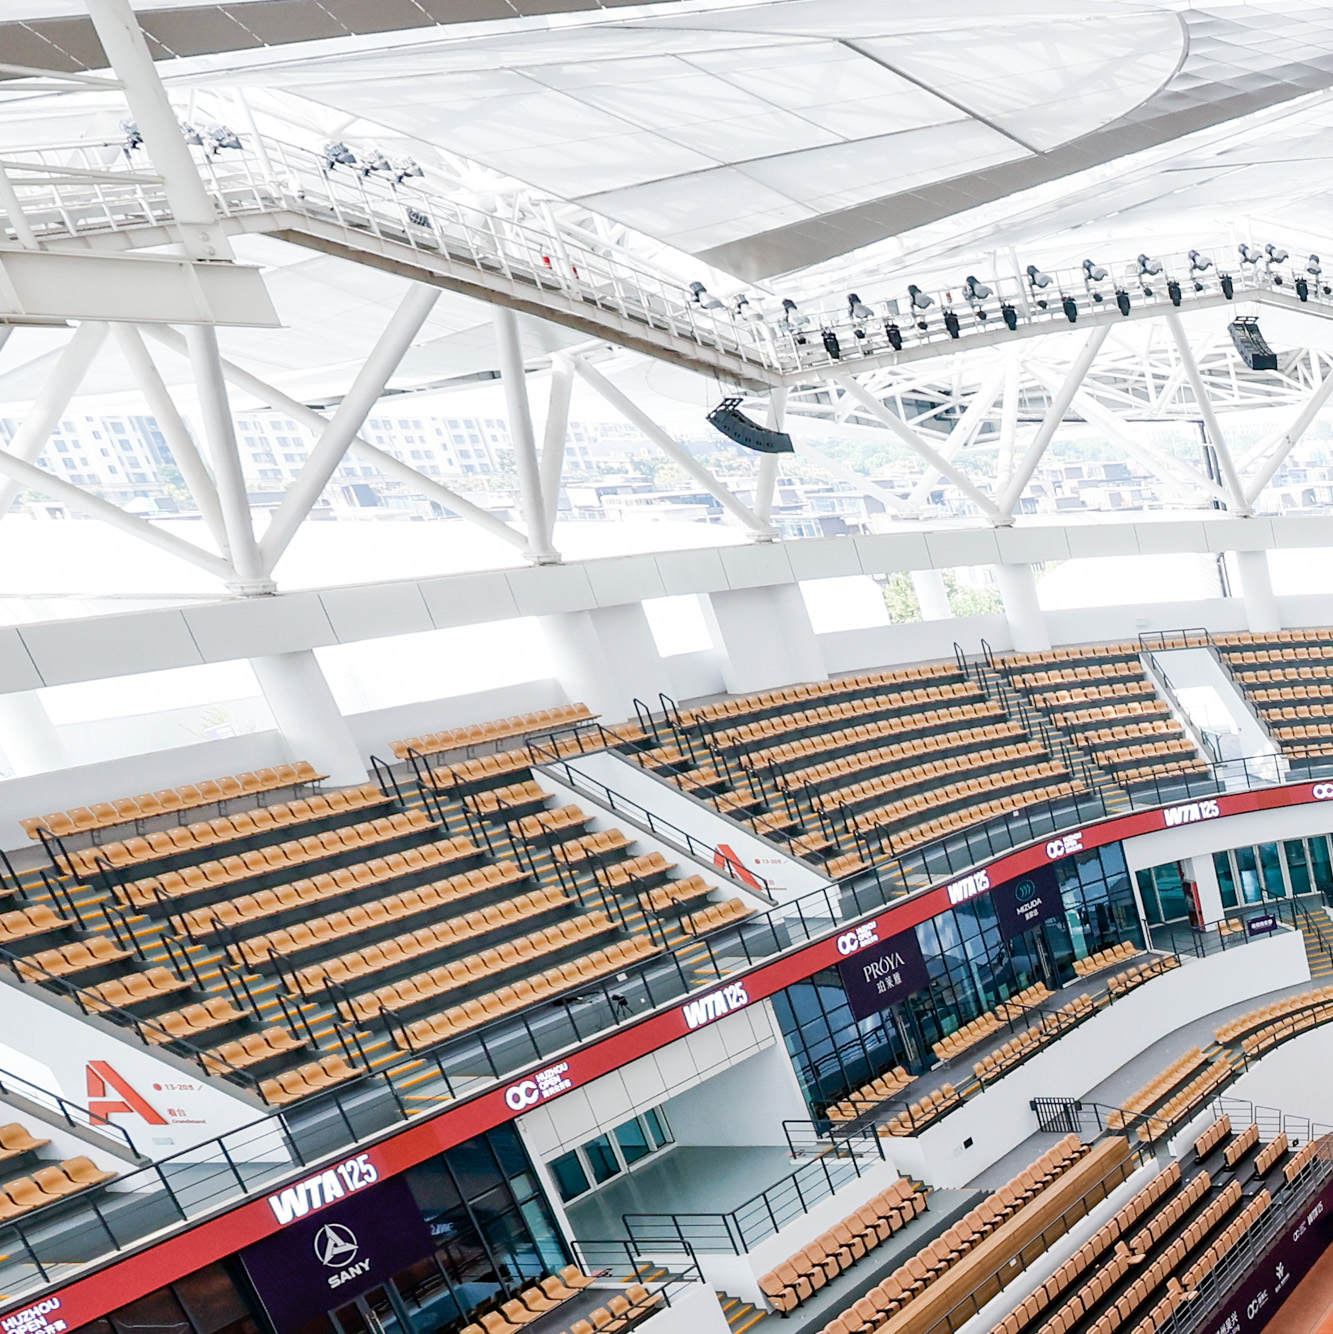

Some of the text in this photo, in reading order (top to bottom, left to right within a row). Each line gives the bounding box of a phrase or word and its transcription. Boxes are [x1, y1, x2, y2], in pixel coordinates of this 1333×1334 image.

[1016, 897, 1042, 915] MIZUDA
[877, 972, 902, 994] 珀莱雅
[535, 1062, 569, 1083] HUZHOU
[538, 1076, 561, 1090] OPEN
[86, 1060, 169, 1125] A
[328, 1258, 370, 1288] SANY
[2, 1297, 61, 1331] HUZHOU
